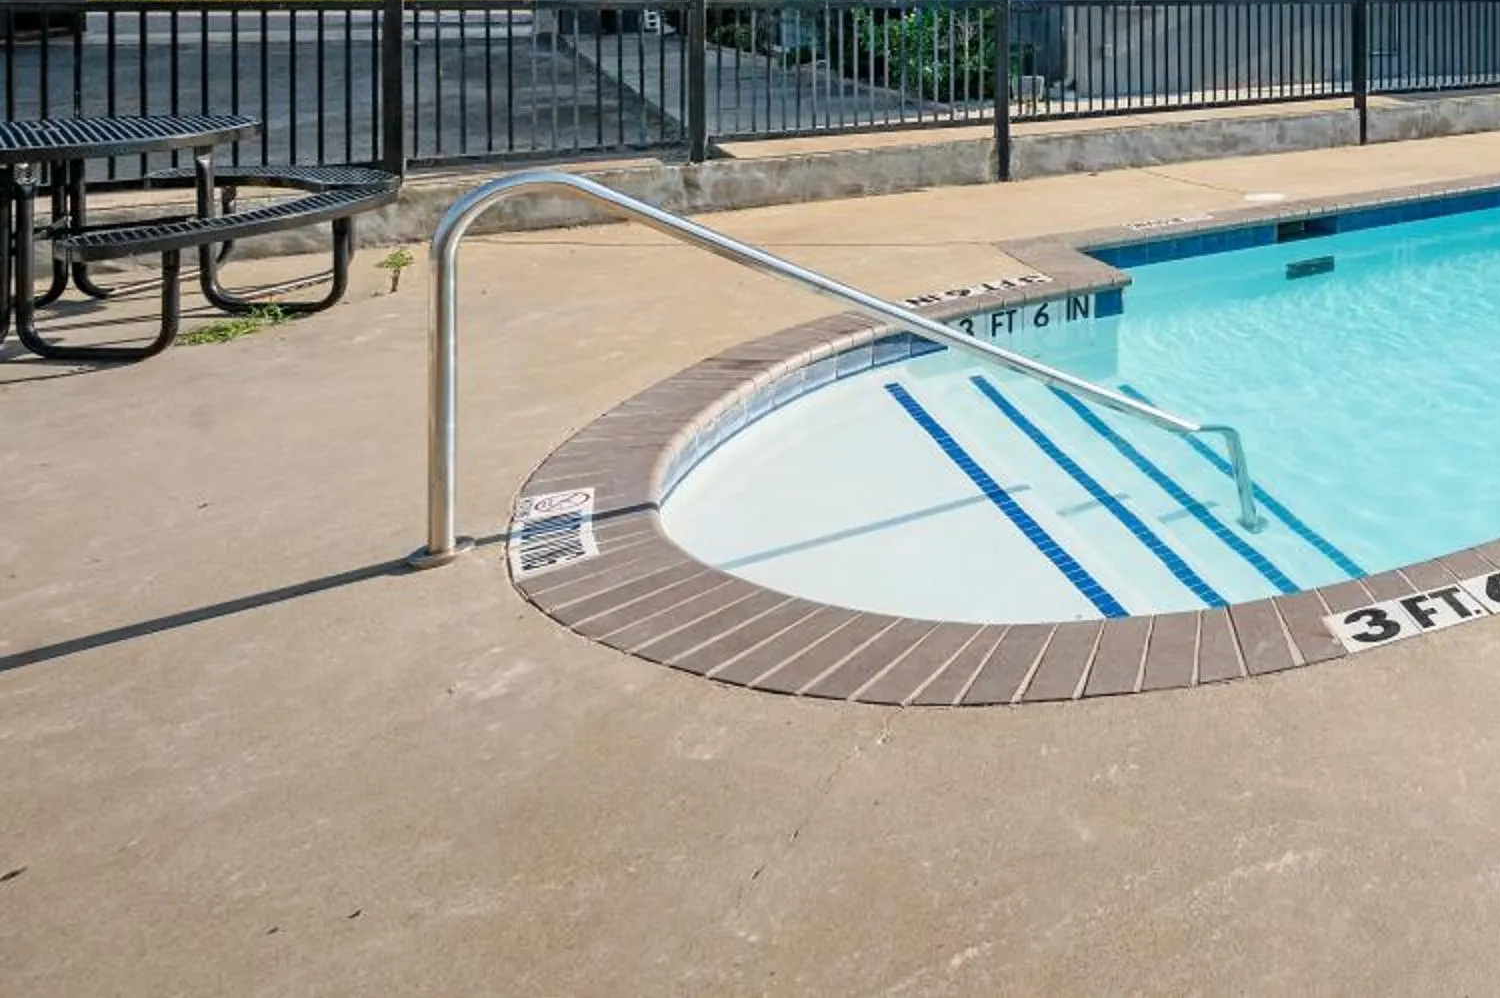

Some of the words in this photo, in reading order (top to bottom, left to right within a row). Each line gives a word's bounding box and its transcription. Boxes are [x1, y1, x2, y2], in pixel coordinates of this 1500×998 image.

[959, 319, 975, 337] 3
[991, 309, 1017, 337] FT
[1033, 303, 1050, 328] 6
[1066, 294, 1090, 323] IN
[1344, 607, 1401, 643] 3
[1400, 586, 1482, 629] FT.
